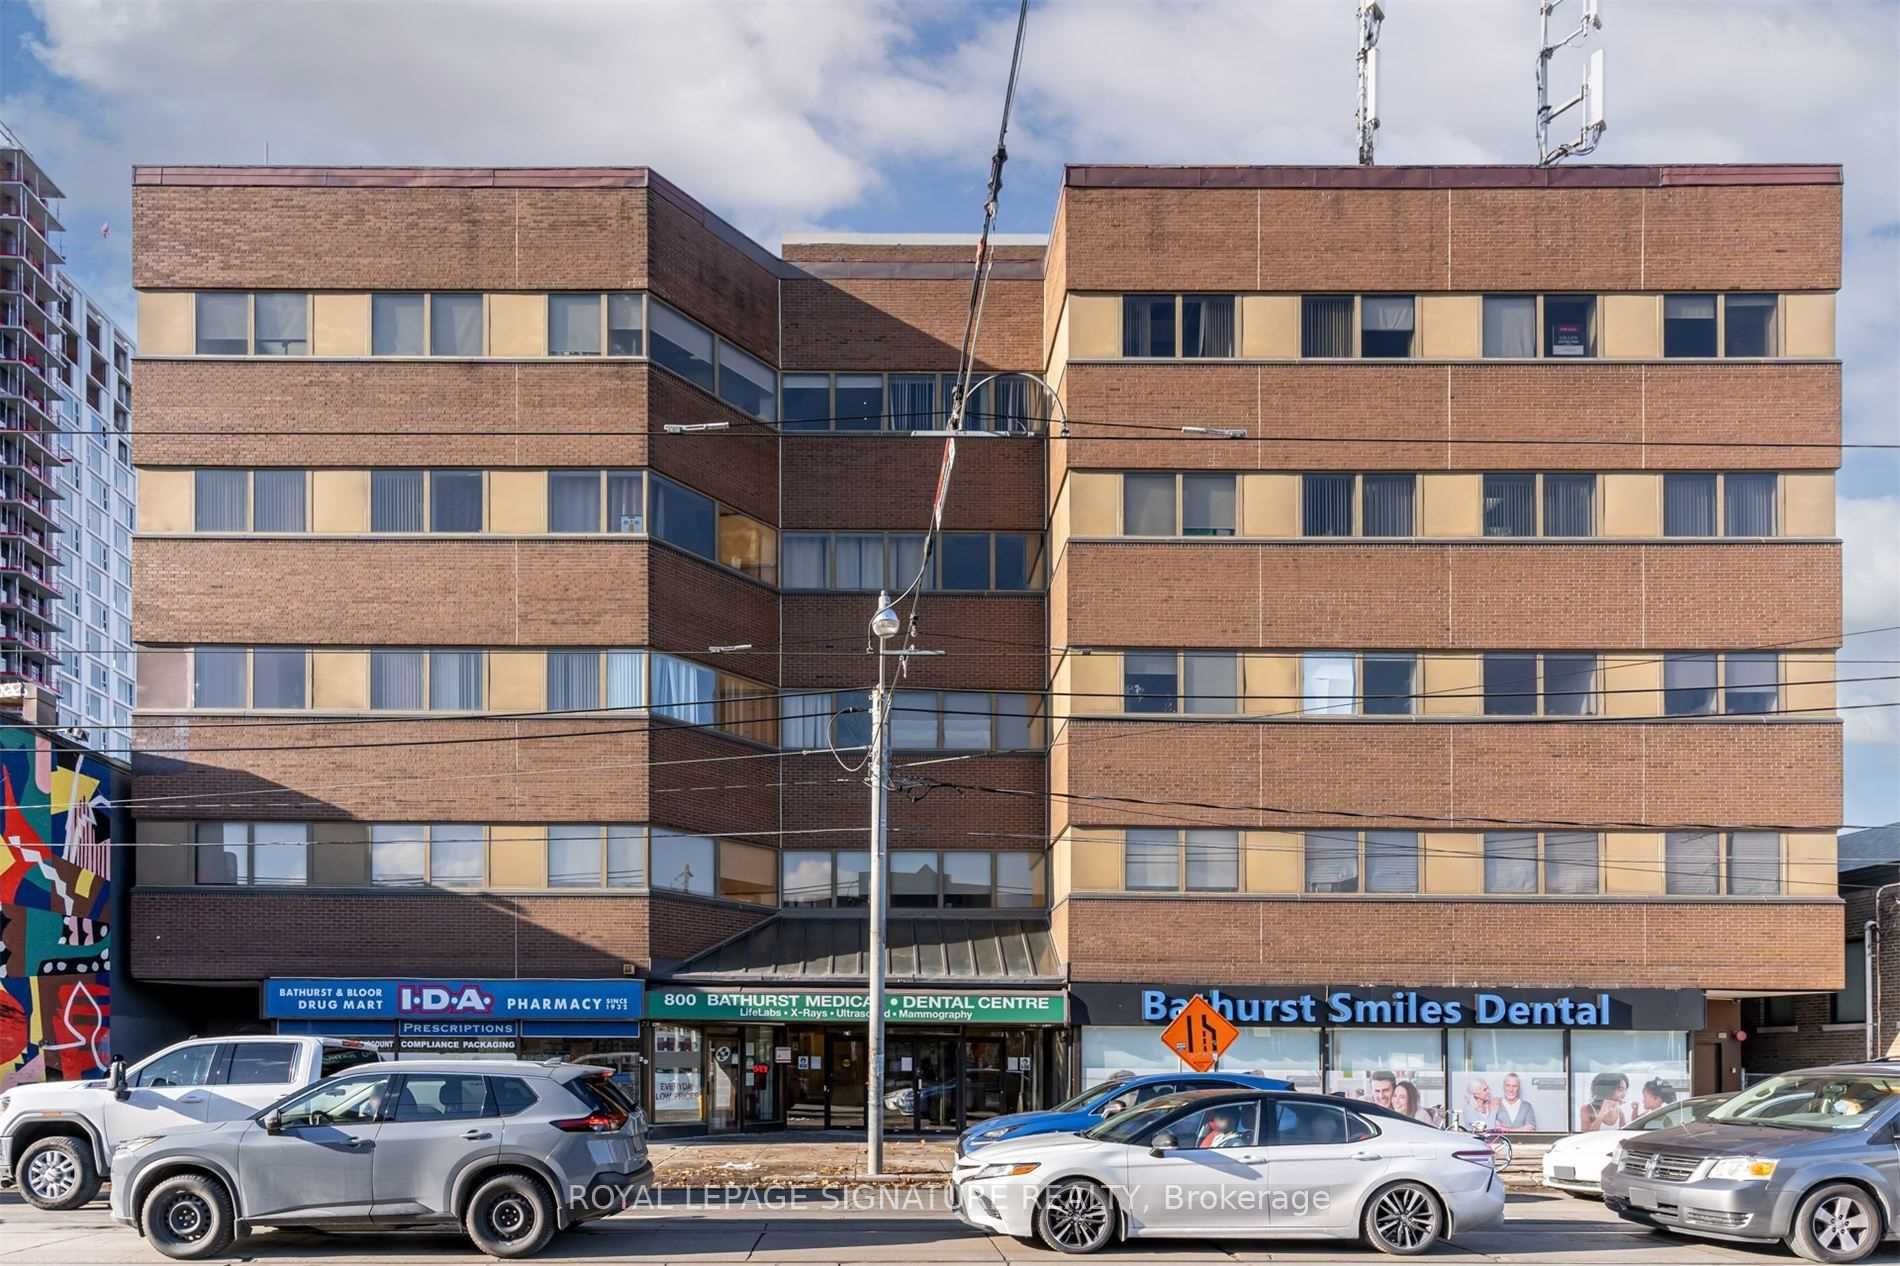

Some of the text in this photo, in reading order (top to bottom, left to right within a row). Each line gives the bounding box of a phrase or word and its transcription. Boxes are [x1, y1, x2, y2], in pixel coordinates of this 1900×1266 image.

[279, 988, 383, 997] BATHURST & BLOOR
[298, 1000, 384, 1009] DRUG MART
[507, 998, 602, 1010] PHARMACY
[664, 994, 1049, 1009] 800 BATHURST MEDICA DENTAL CENTRE
[1142, 990, 1609, 1025] Bahurst Smiles Dental
[740, 1008, 782, 1017] LifeLabs
[790, 1009, 828, 1018] X-Rays
[899, 1010, 973, 1020] Mammography
[403, 1023, 513, 1033] PRESCRIPTIONS
[401, 1041, 515, 1049] COMPLIANCE PACKAGING
